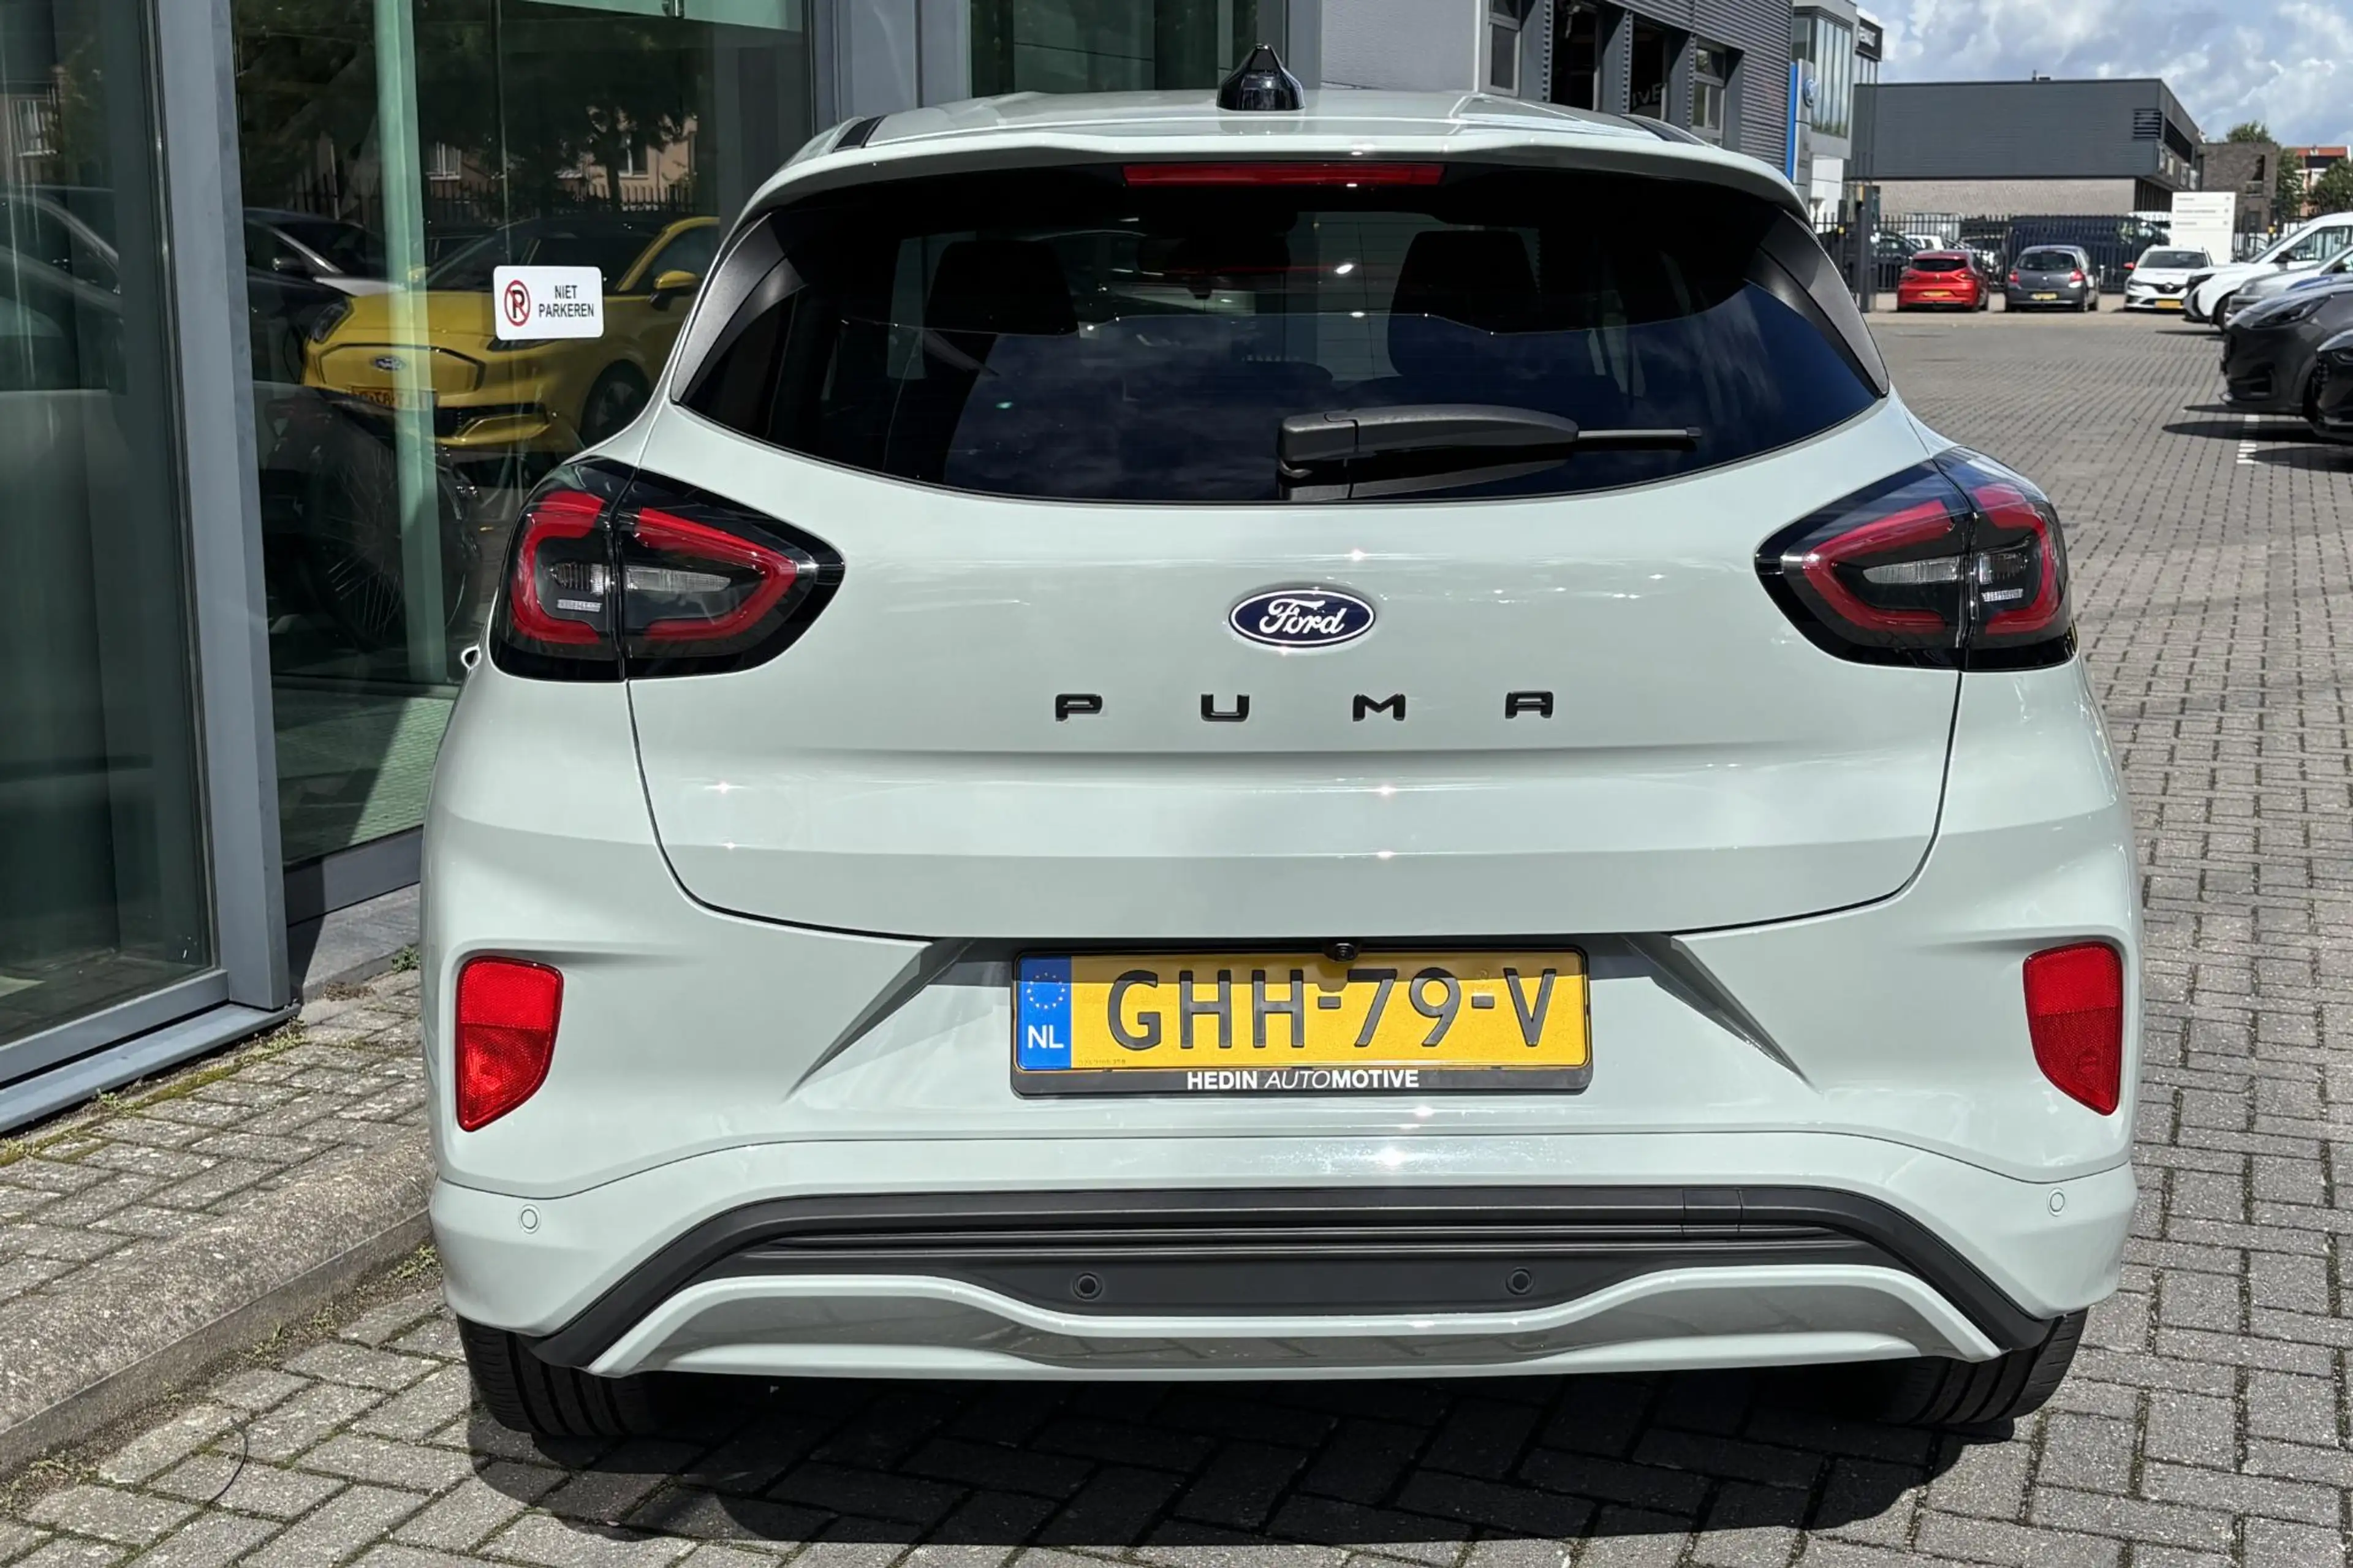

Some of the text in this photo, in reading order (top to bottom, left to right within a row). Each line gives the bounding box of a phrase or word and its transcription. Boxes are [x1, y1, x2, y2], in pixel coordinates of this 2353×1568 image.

[555, 285, 577, 299] NIET
[539, 303, 594, 317] PARKEREN
[1259, 598, 1347, 634] Ford
[1055, 690, 1554, 722] PUMA
[1107, 966, 1556, 1050] GHH-79-V
[1028, 1025, 1064, 1049] NL
[1187, 1069, 1419, 1090] HEDIN AUTOMOTIVE
